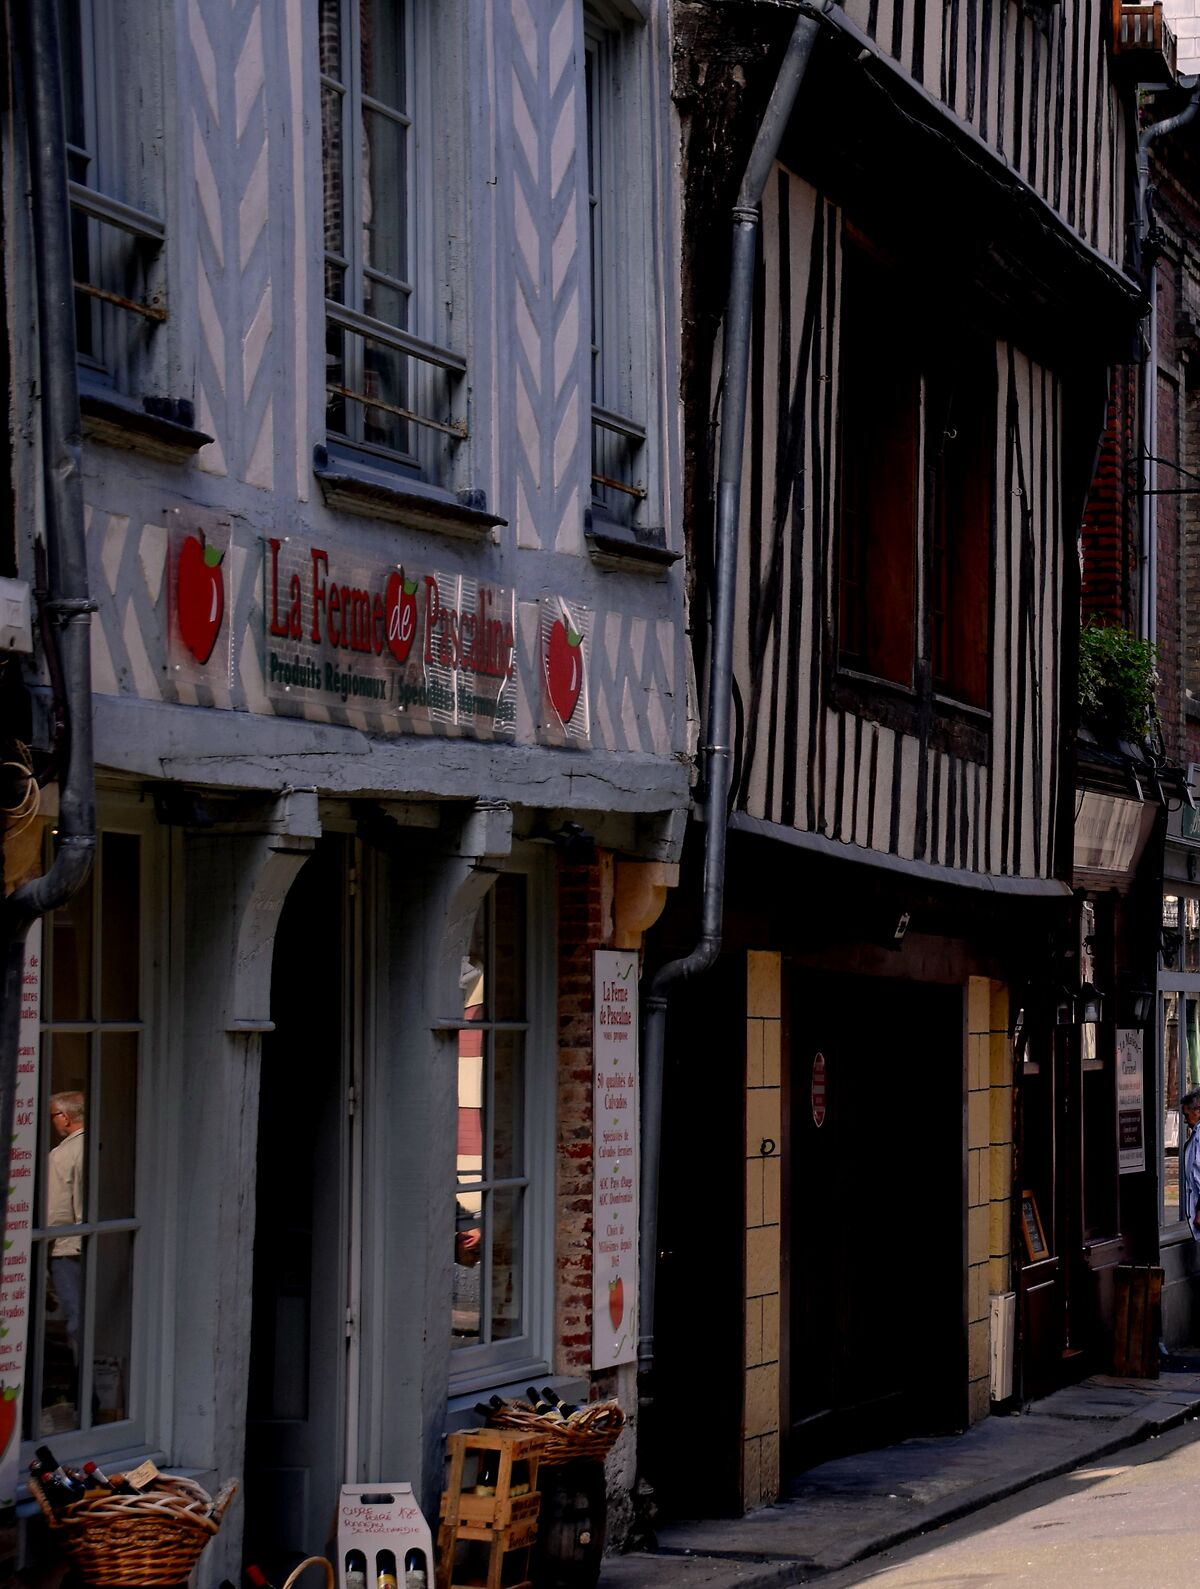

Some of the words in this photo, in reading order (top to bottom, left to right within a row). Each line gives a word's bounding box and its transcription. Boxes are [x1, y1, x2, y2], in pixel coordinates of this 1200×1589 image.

[268, 537, 302, 641] La
[310, 548, 385, 656] Ferme
[389, 585, 412, 641] de
[269, 651, 322, 690] Produits
[324, 660, 387, 701] Régionaux
[603, 981, 610, 1001] La
[611, 981, 628, 1001] Ferme
[600, 1004, 606, 1025] de
[607, 1005, 631, 1025] Pascaline
[628, 1072, 634, 1088] de
[605, 1094, 627, 1110] Calvados
